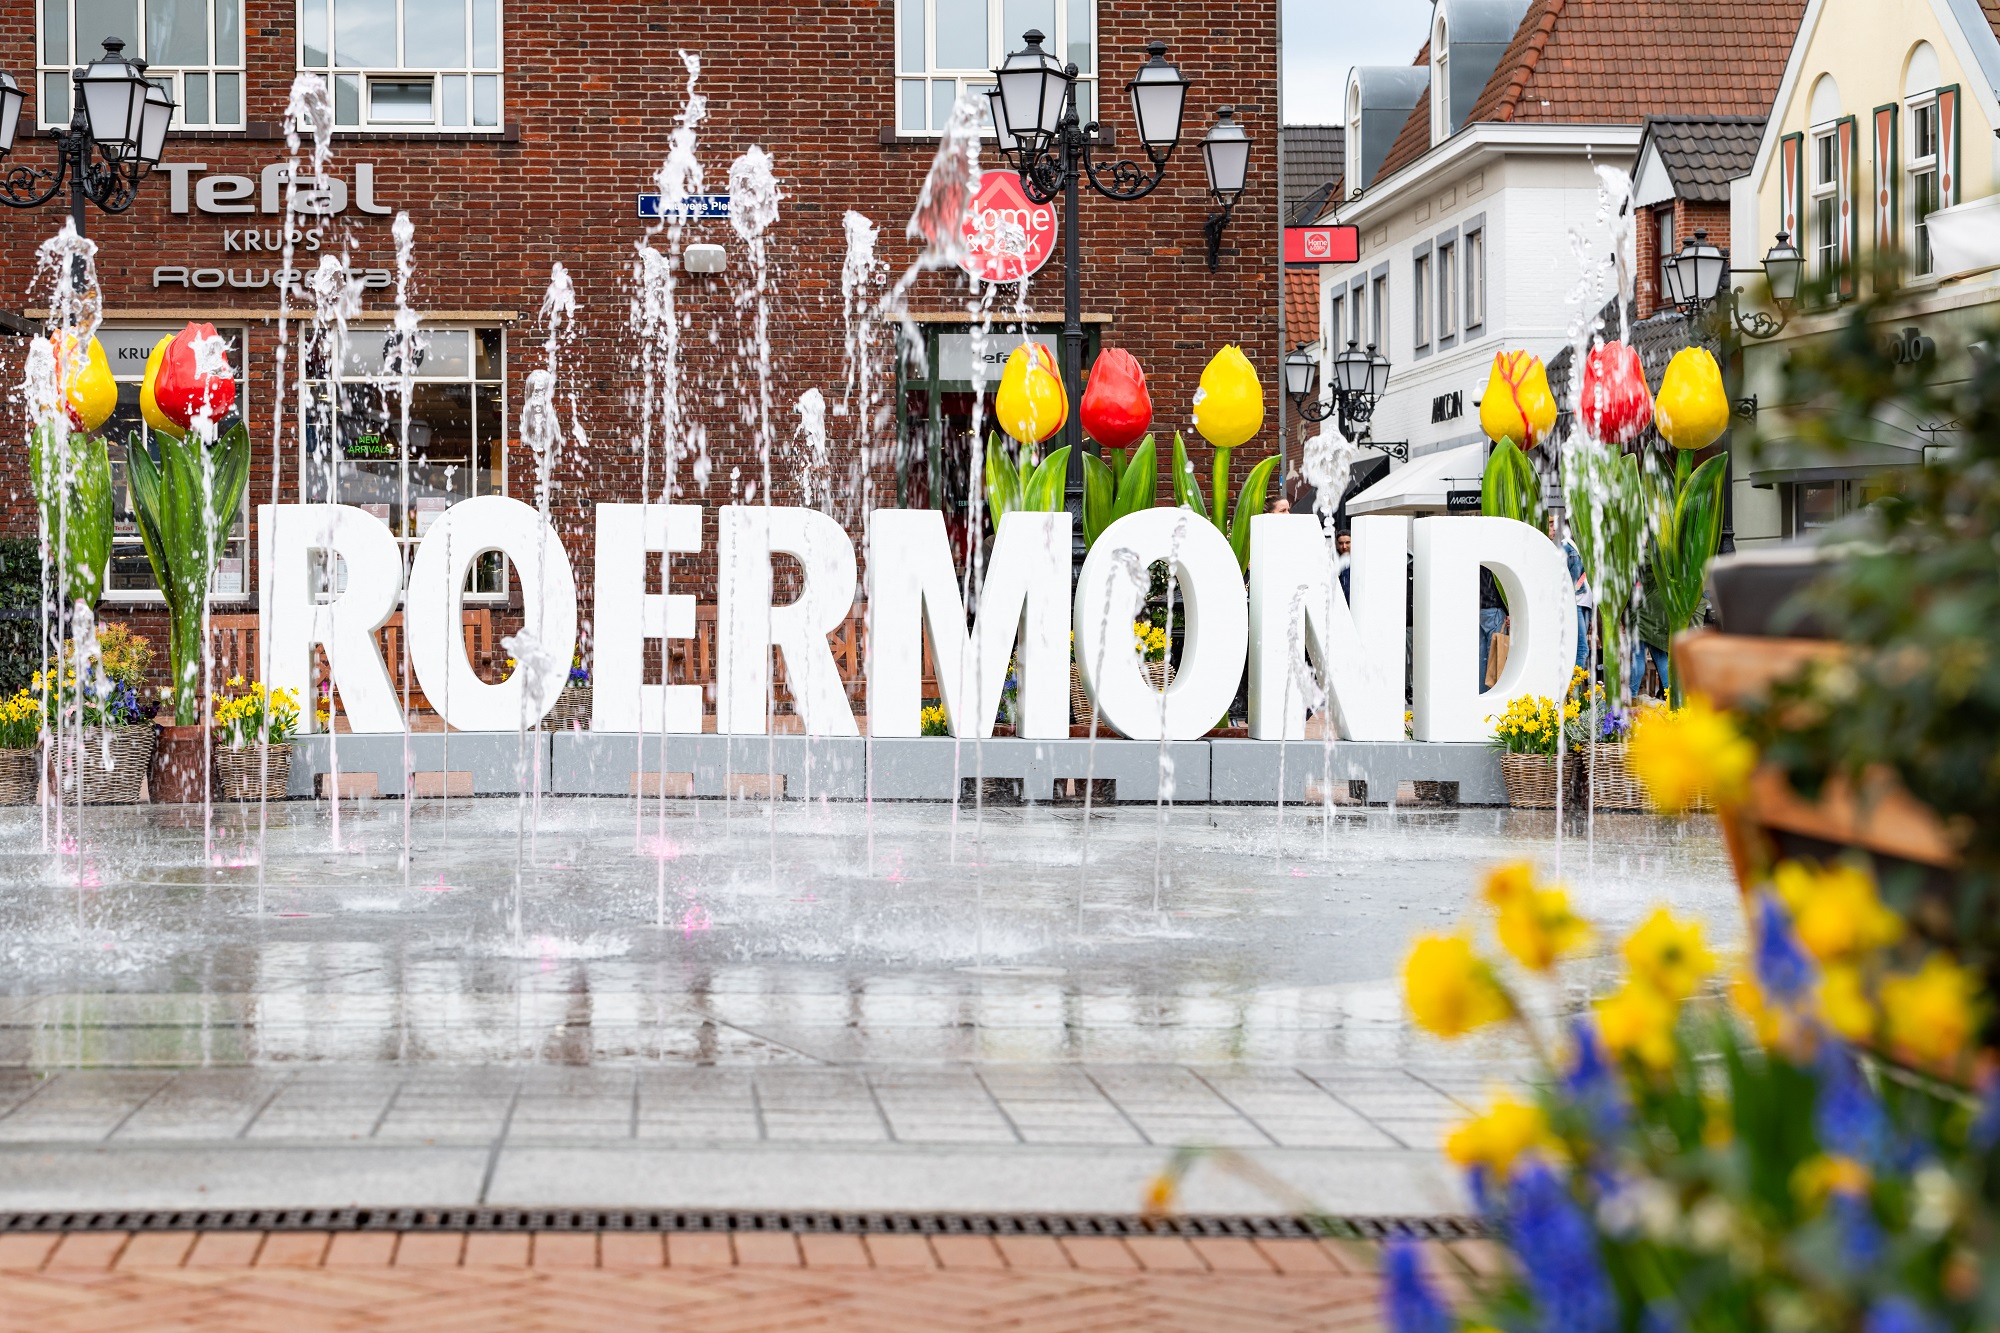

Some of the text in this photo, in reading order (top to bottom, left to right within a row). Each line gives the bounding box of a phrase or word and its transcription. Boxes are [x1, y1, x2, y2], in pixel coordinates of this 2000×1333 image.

[152, 163, 392, 214] Tefal
[711, 201, 732, 211] Plei
[224, 229, 320, 250] KRUPS
[118, 347, 154, 360] KRU
[358, 436, 380, 444] NEW
[347, 445, 391, 454] ARRIVALS
[257, 495, 1578, 743] ROERMOND
